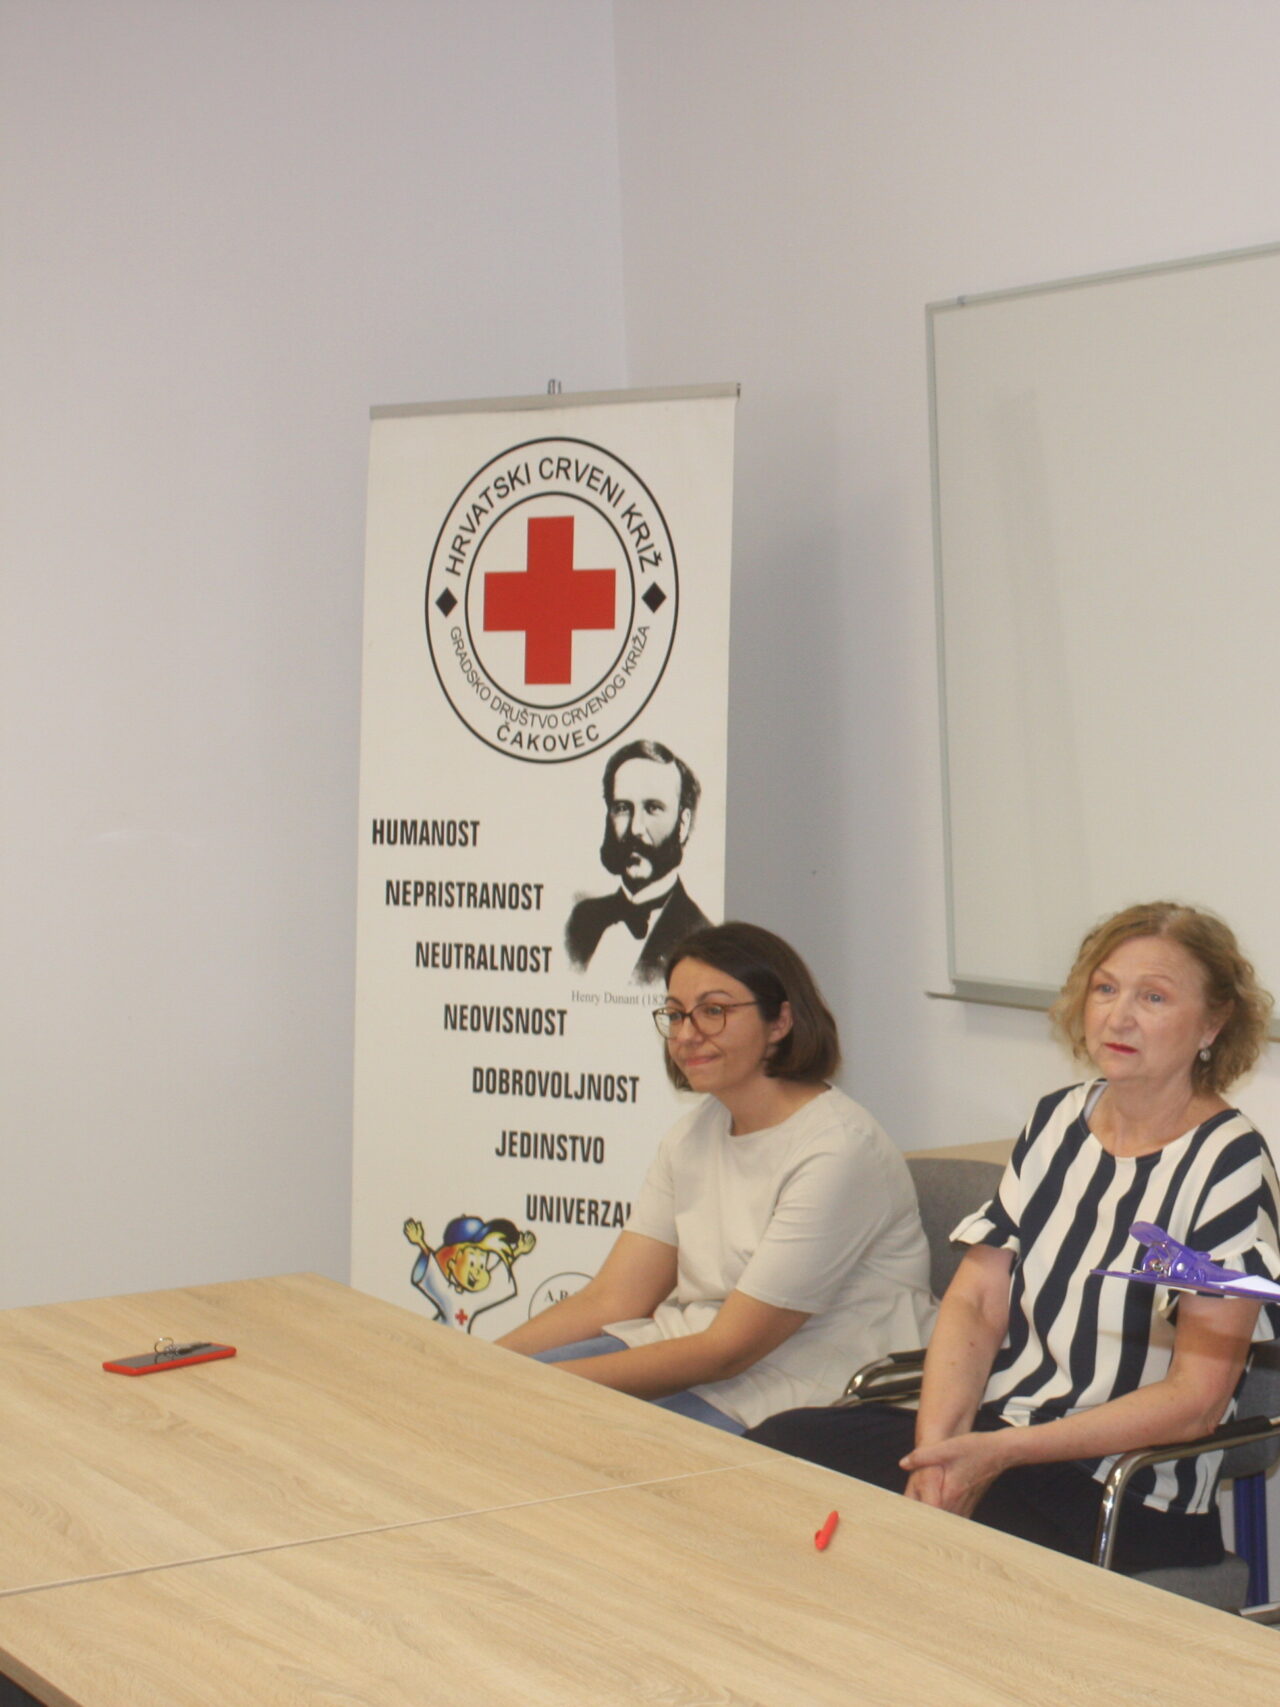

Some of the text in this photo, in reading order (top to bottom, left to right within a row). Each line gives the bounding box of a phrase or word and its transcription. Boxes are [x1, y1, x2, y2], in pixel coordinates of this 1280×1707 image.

[445, 457, 663, 576] HRVATSKI CRVENI KRIŽ
[450, 624, 650, 729] GRADSKO DRUŠTVO CRVENOG KRIŽA
[496, 722, 600, 752] ČAKOVEC
[372, 819, 480, 847] HUMANOST
[385, 880, 544, 911] NEPRISTRANOST
[415, 941, 552, 973] NEUTRALNOST
[571, 990, 600, 1006] Henry
[603, 992, 639, 1005] Dunant
[444, 1004, 567, 1036] NEOVISNOST
[472, 1066, 639, 1103] DOBROVOLJNOST
[495, 1130, 605, 1164] JEDINSTVO
